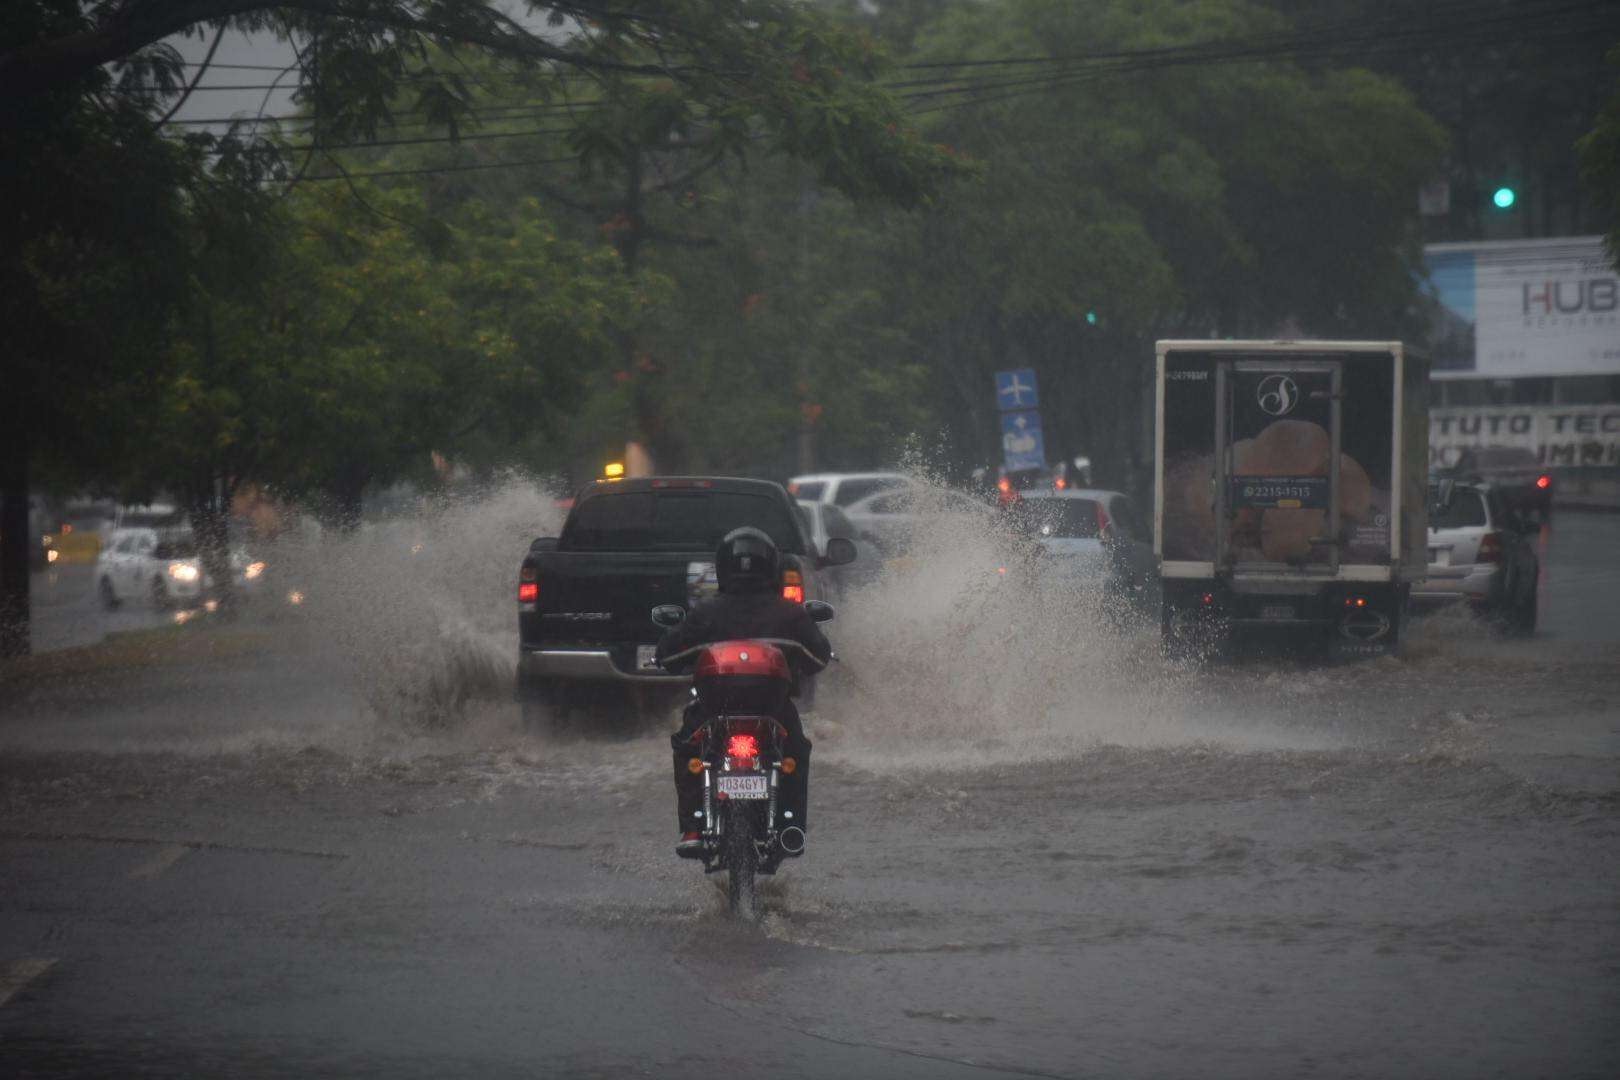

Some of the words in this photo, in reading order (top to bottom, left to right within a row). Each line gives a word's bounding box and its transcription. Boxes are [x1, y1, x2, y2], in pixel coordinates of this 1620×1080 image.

[1523, 279, 1617, 316] HUB
[1437, 415, 1532, 434] TUTO
[729, 791, 769, 800] SUZUKI
